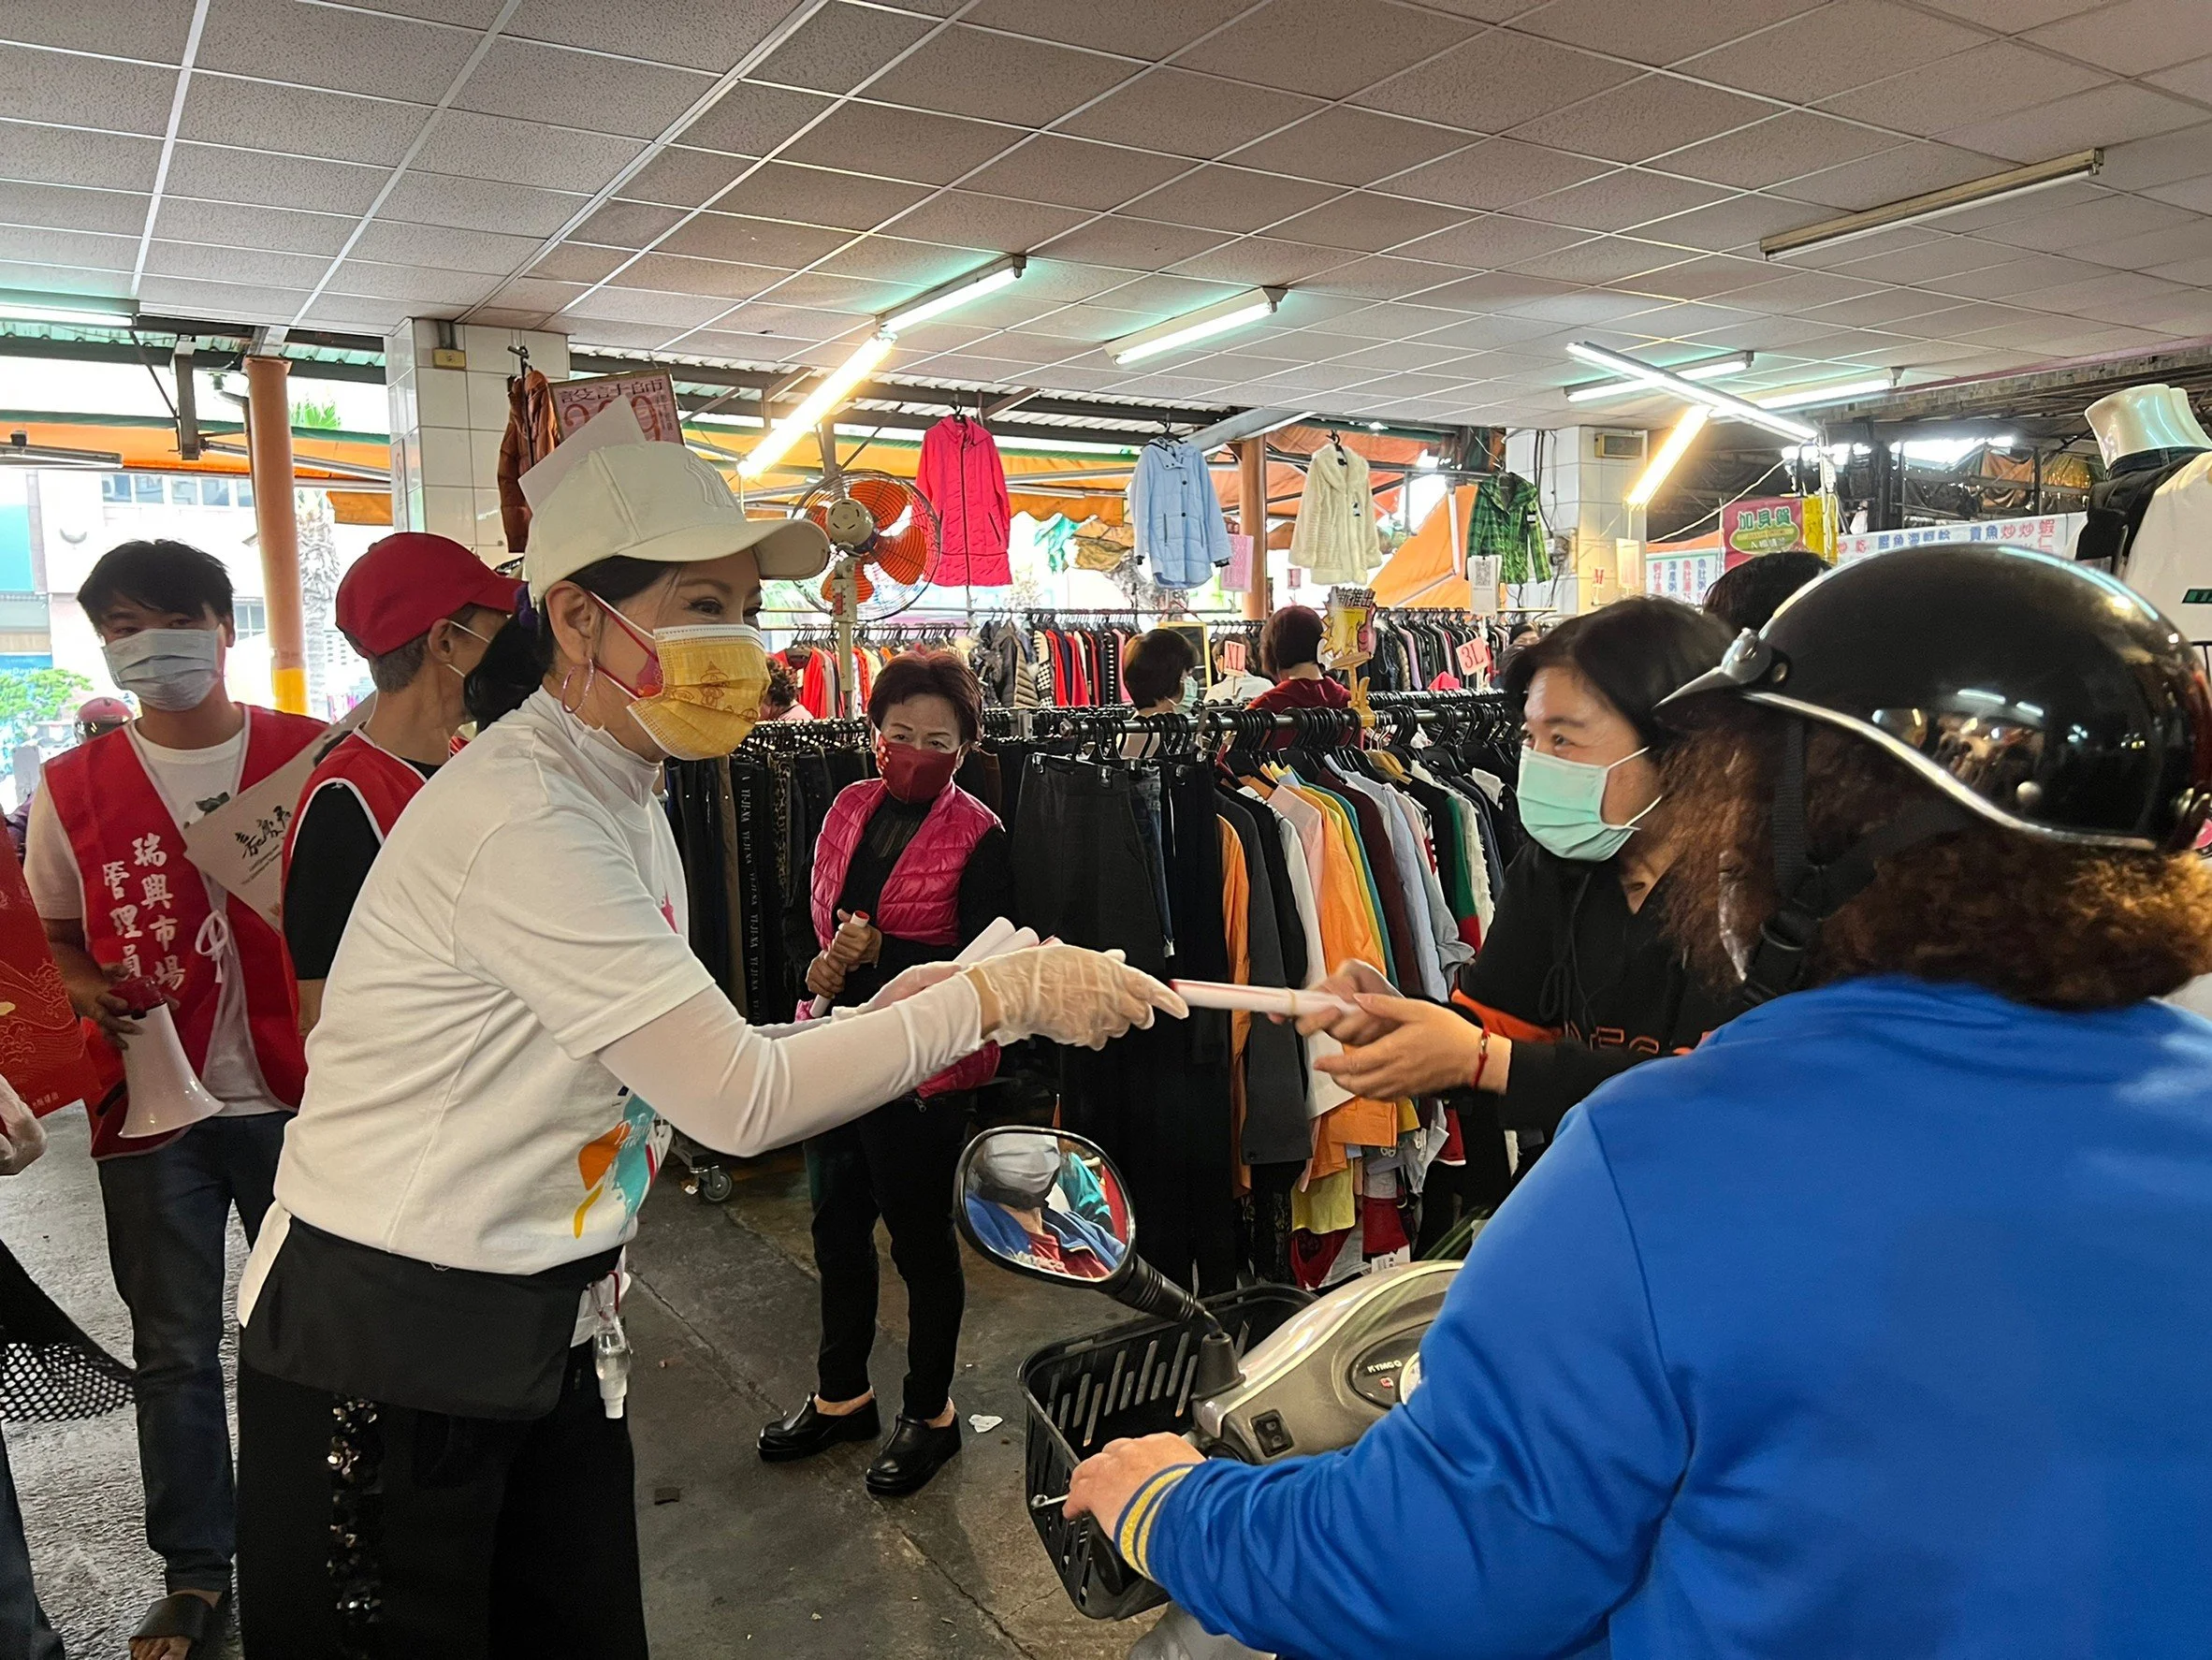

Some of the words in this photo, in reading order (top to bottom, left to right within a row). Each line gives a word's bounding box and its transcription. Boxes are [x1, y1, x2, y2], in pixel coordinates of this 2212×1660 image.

[560, 378, 662, 404] 設計師
[1226, 643, 1244, 671] XL
[1461, 643, 1484, 669] 3L
[132, 832, 186, 990] 瑞興市場
[1366, 1360, 1403, 1374] KYMCO
